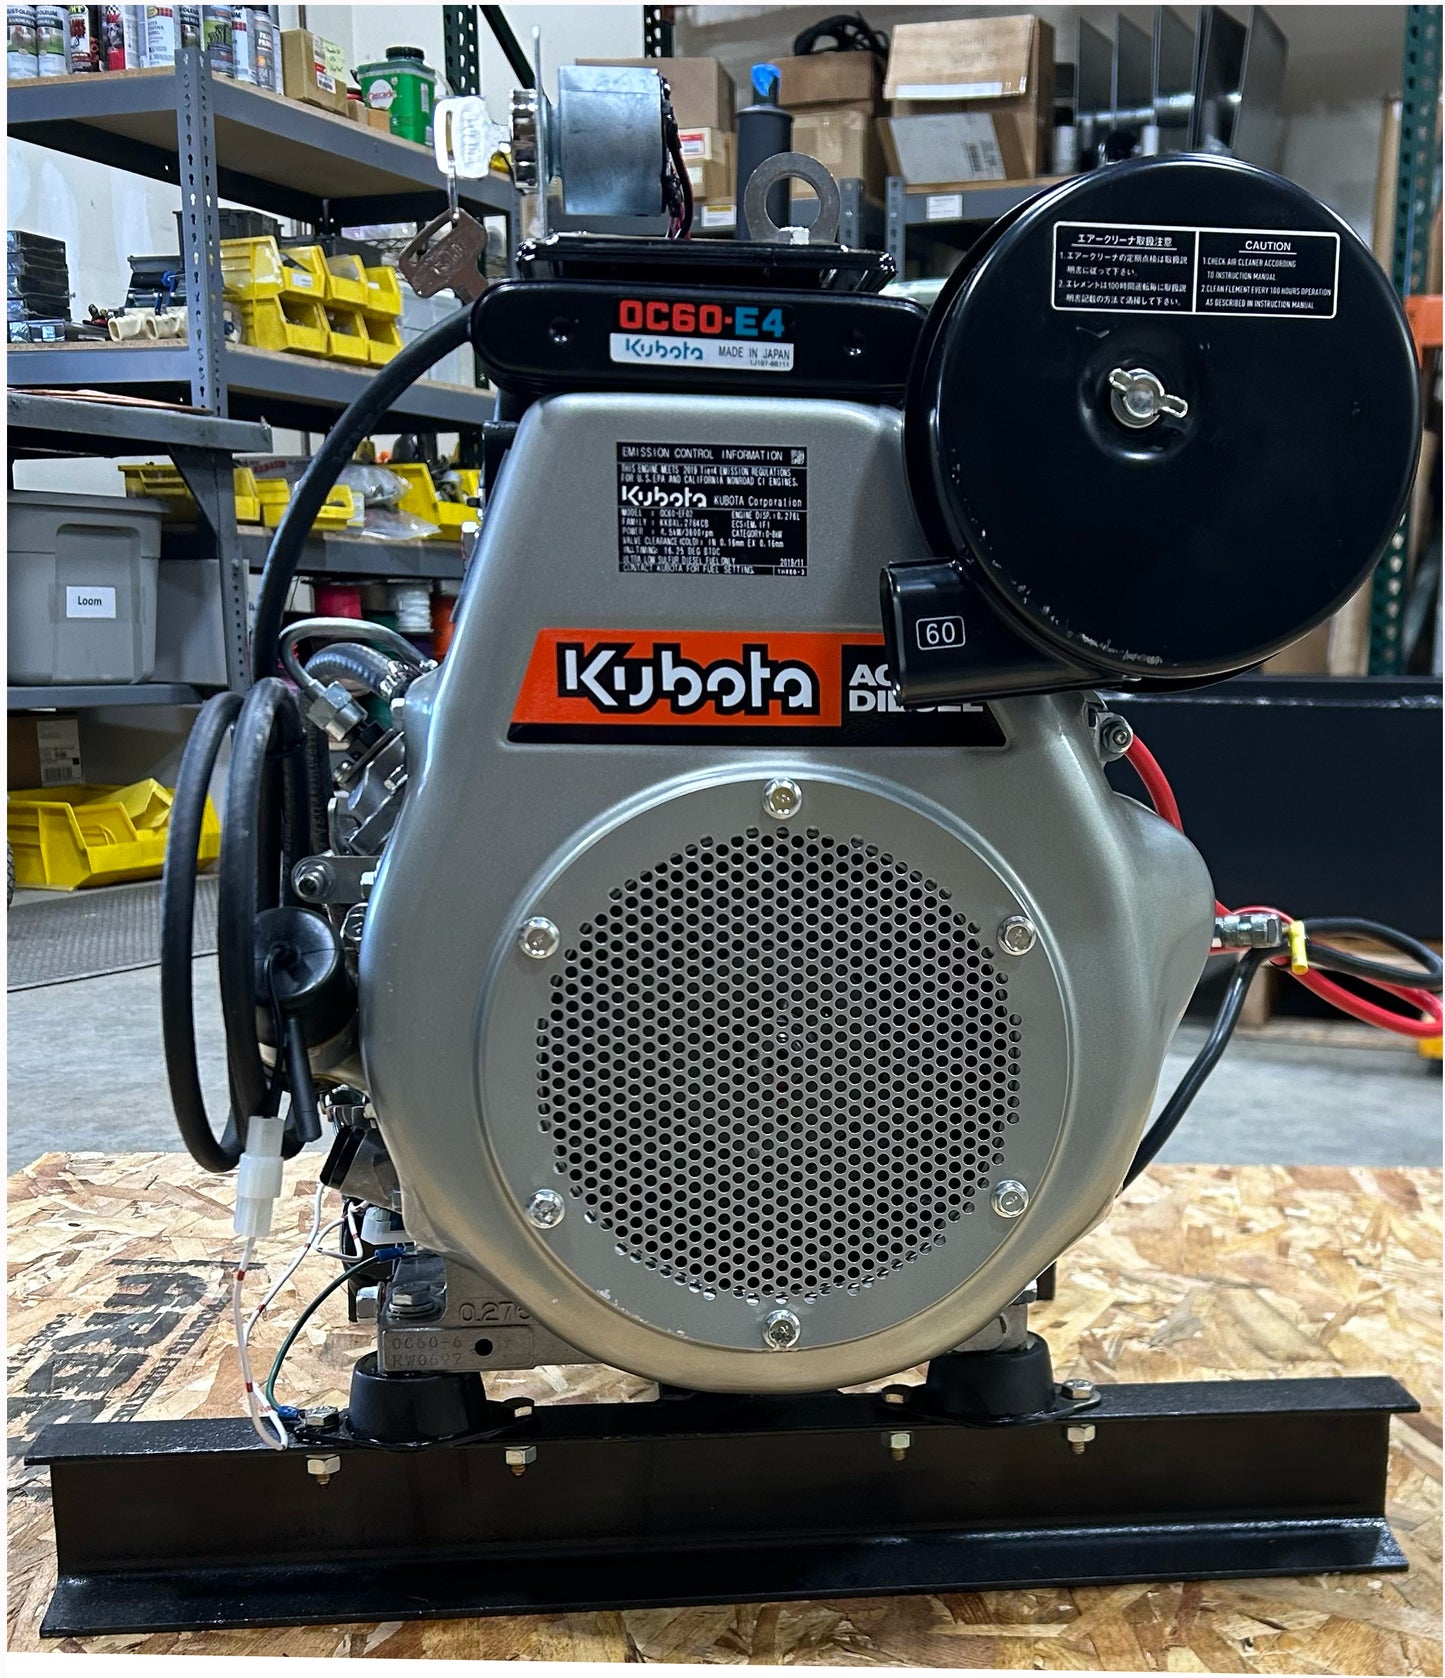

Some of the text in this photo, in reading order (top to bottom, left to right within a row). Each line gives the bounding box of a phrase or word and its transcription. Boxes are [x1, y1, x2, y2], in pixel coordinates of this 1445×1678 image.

[1245, 240, 1292, 251] CAUTION
[1227, 257, 1237, 266] AIR
[1238, 258, 1264, 267] CLEANER
[1264, 259, 1297, 268] ACCORDING
[1207, 271, 1214, 279] TO
[1215, 271, 1252, 280] INSTRUCTION
[1225, 285, 1250, 294] ELEMENT
[1251, 286, 1268, 294] EVERY
[1270, 287, 1280, 295] 100
[1281, 287, 1300, 295] HOURS
[1301, 287, 1331, 296] OPERATION
[1205, 298, 1213, 306] AS
[1214, 299, 1246, 307] DESCRIBED
[1247, 300, 1253, 308] IN
[1254, 300, 1291, 308] INSTRUCTION
[626, 338, 790, 361] Kubota MADE IN JAPAN
[622, 446, 783, 461] EMISSION CONTROL INFORMATION
[621, 463, 636, 473] THIS
[637, 464, 658, 473] ENGINE
[660, 464, 679, 474] MEETS
[720, 466, 749, 476] EMISSION
[751, 466, 791, 477] REGULATIONS
[621, 473, 634, 482] FOR
[668, 474, 681, 484] AND
[684, 475, 724, 485] CALIFORNIA
[726, 476, 755, 486] NONROAD
[621, 485, 803, 508] Kubota KUBOTA Corporation
[621, 508, 642, 517] MODEL
[731, 510, 753, 519] ENGINE
[621, 517, 647, 526] FAMILY
[622, 527, 644, 535] POWER
[622, 536, 641, 545] VALVE
[708, 538, 716, 547] IN
[747, 539, 756, 548] EX
[687, 546, 701, 556] DEG
[703, 546, 721, 556] BTDC
[77, 595, 102, 606] Loom
[926, 622, 955, 645] 60
[565, 648, 813, 708] Kubota
